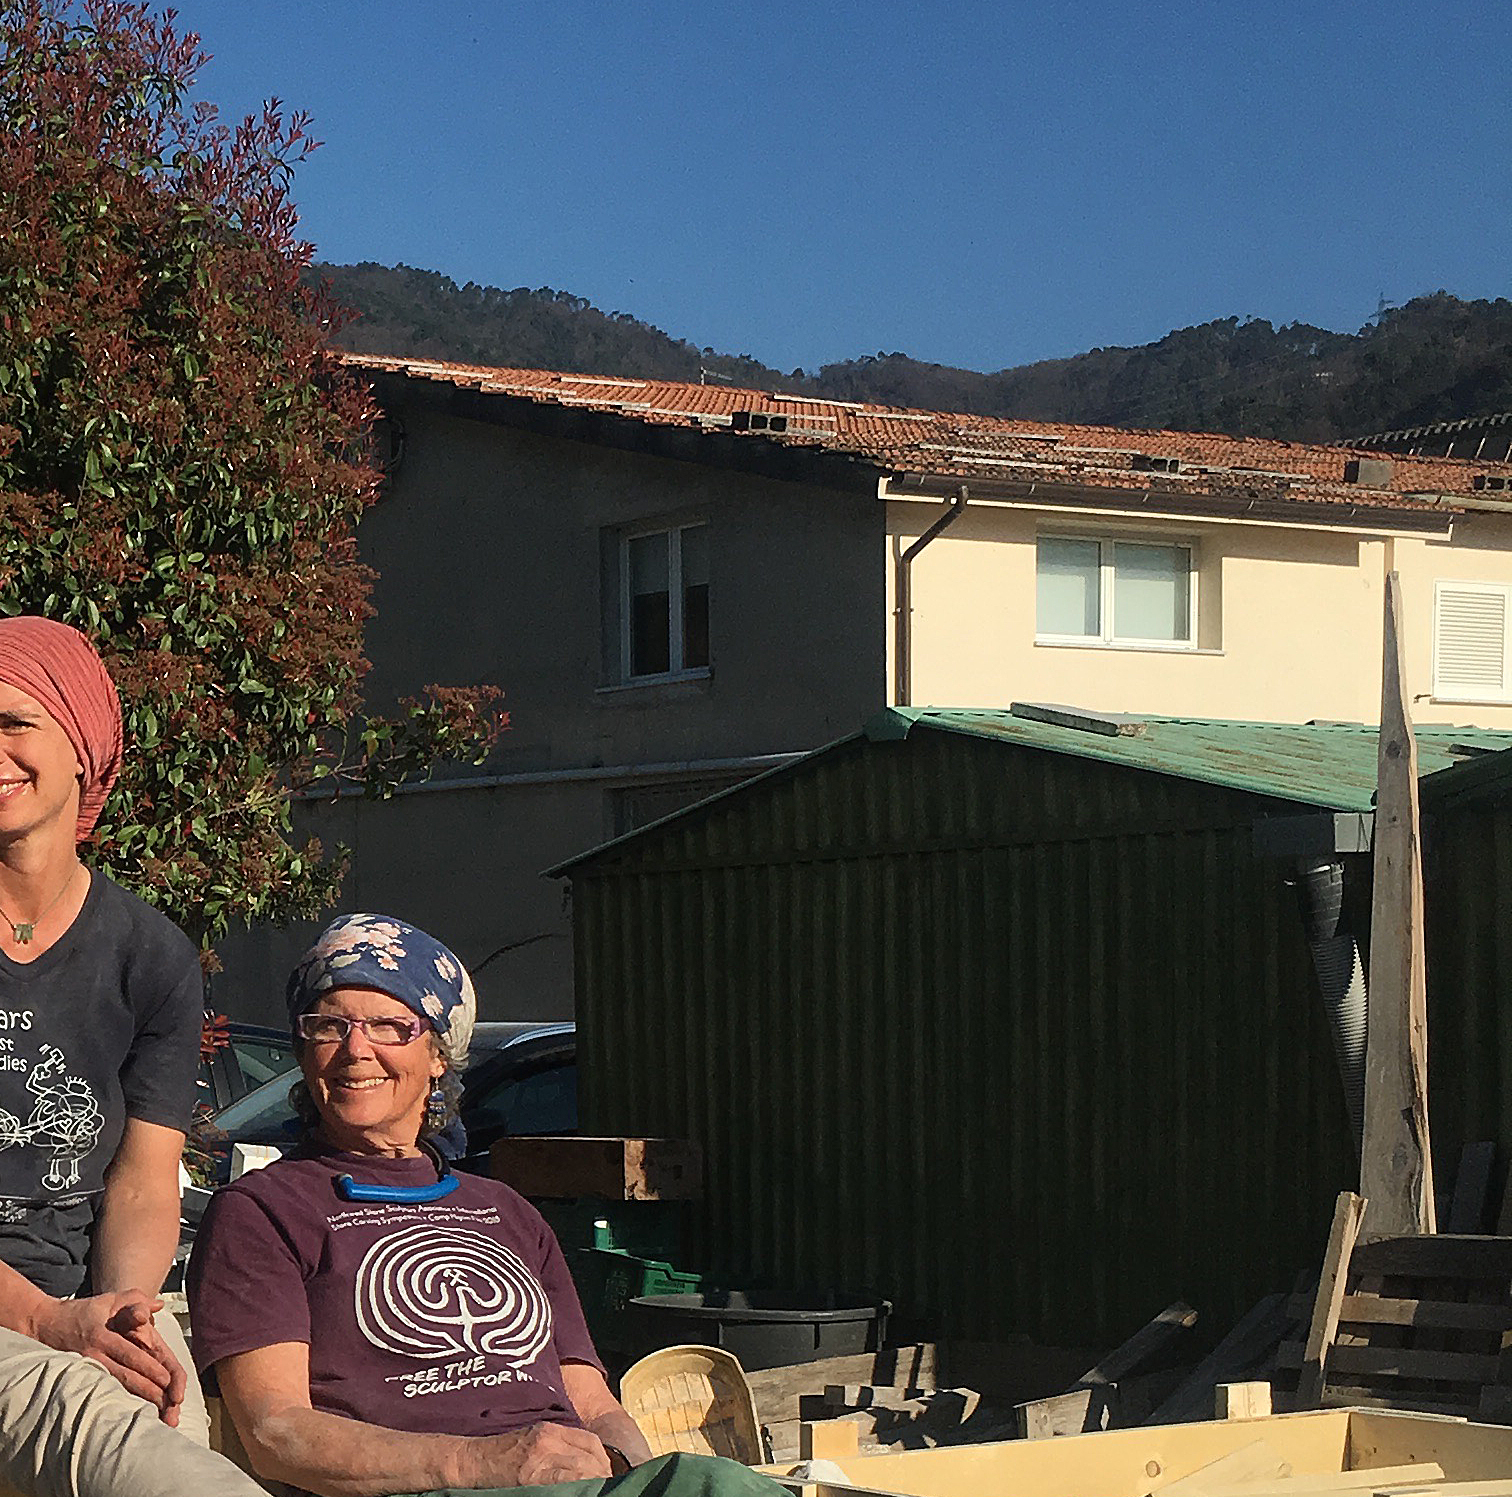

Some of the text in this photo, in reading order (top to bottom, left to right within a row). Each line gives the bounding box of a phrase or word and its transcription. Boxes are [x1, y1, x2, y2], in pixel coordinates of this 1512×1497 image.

[385, 1355, 486, 1382] REE THE
[403, 1370, 512, 1398] SCULPTOR
